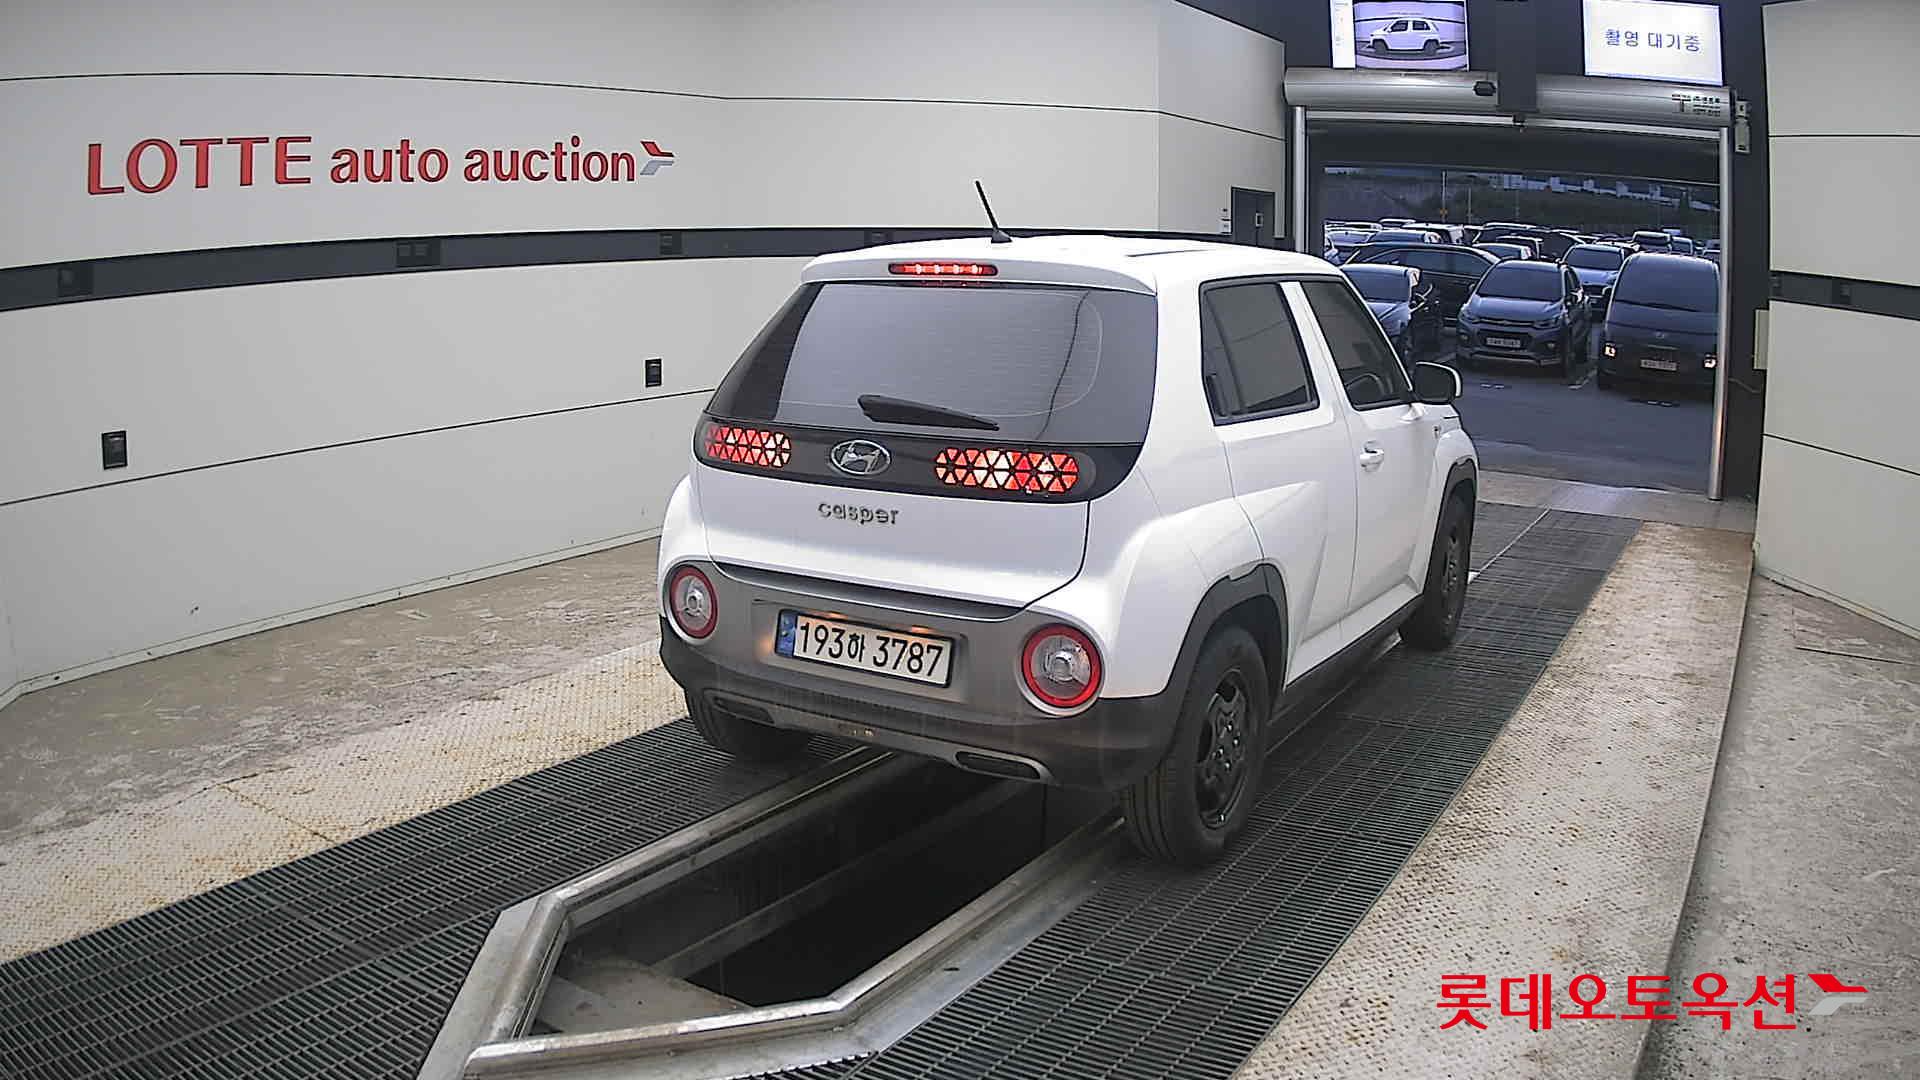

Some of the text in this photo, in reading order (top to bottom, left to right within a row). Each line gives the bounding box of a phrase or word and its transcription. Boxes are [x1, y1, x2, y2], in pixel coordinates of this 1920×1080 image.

[1605, 28, 1701, 52] 촬영 대기중
[87, 135, 636, 195] LOTTE auto auction
[818, 503, 899, 525] casper
[800, 621, 943, 677] 193하 3787
